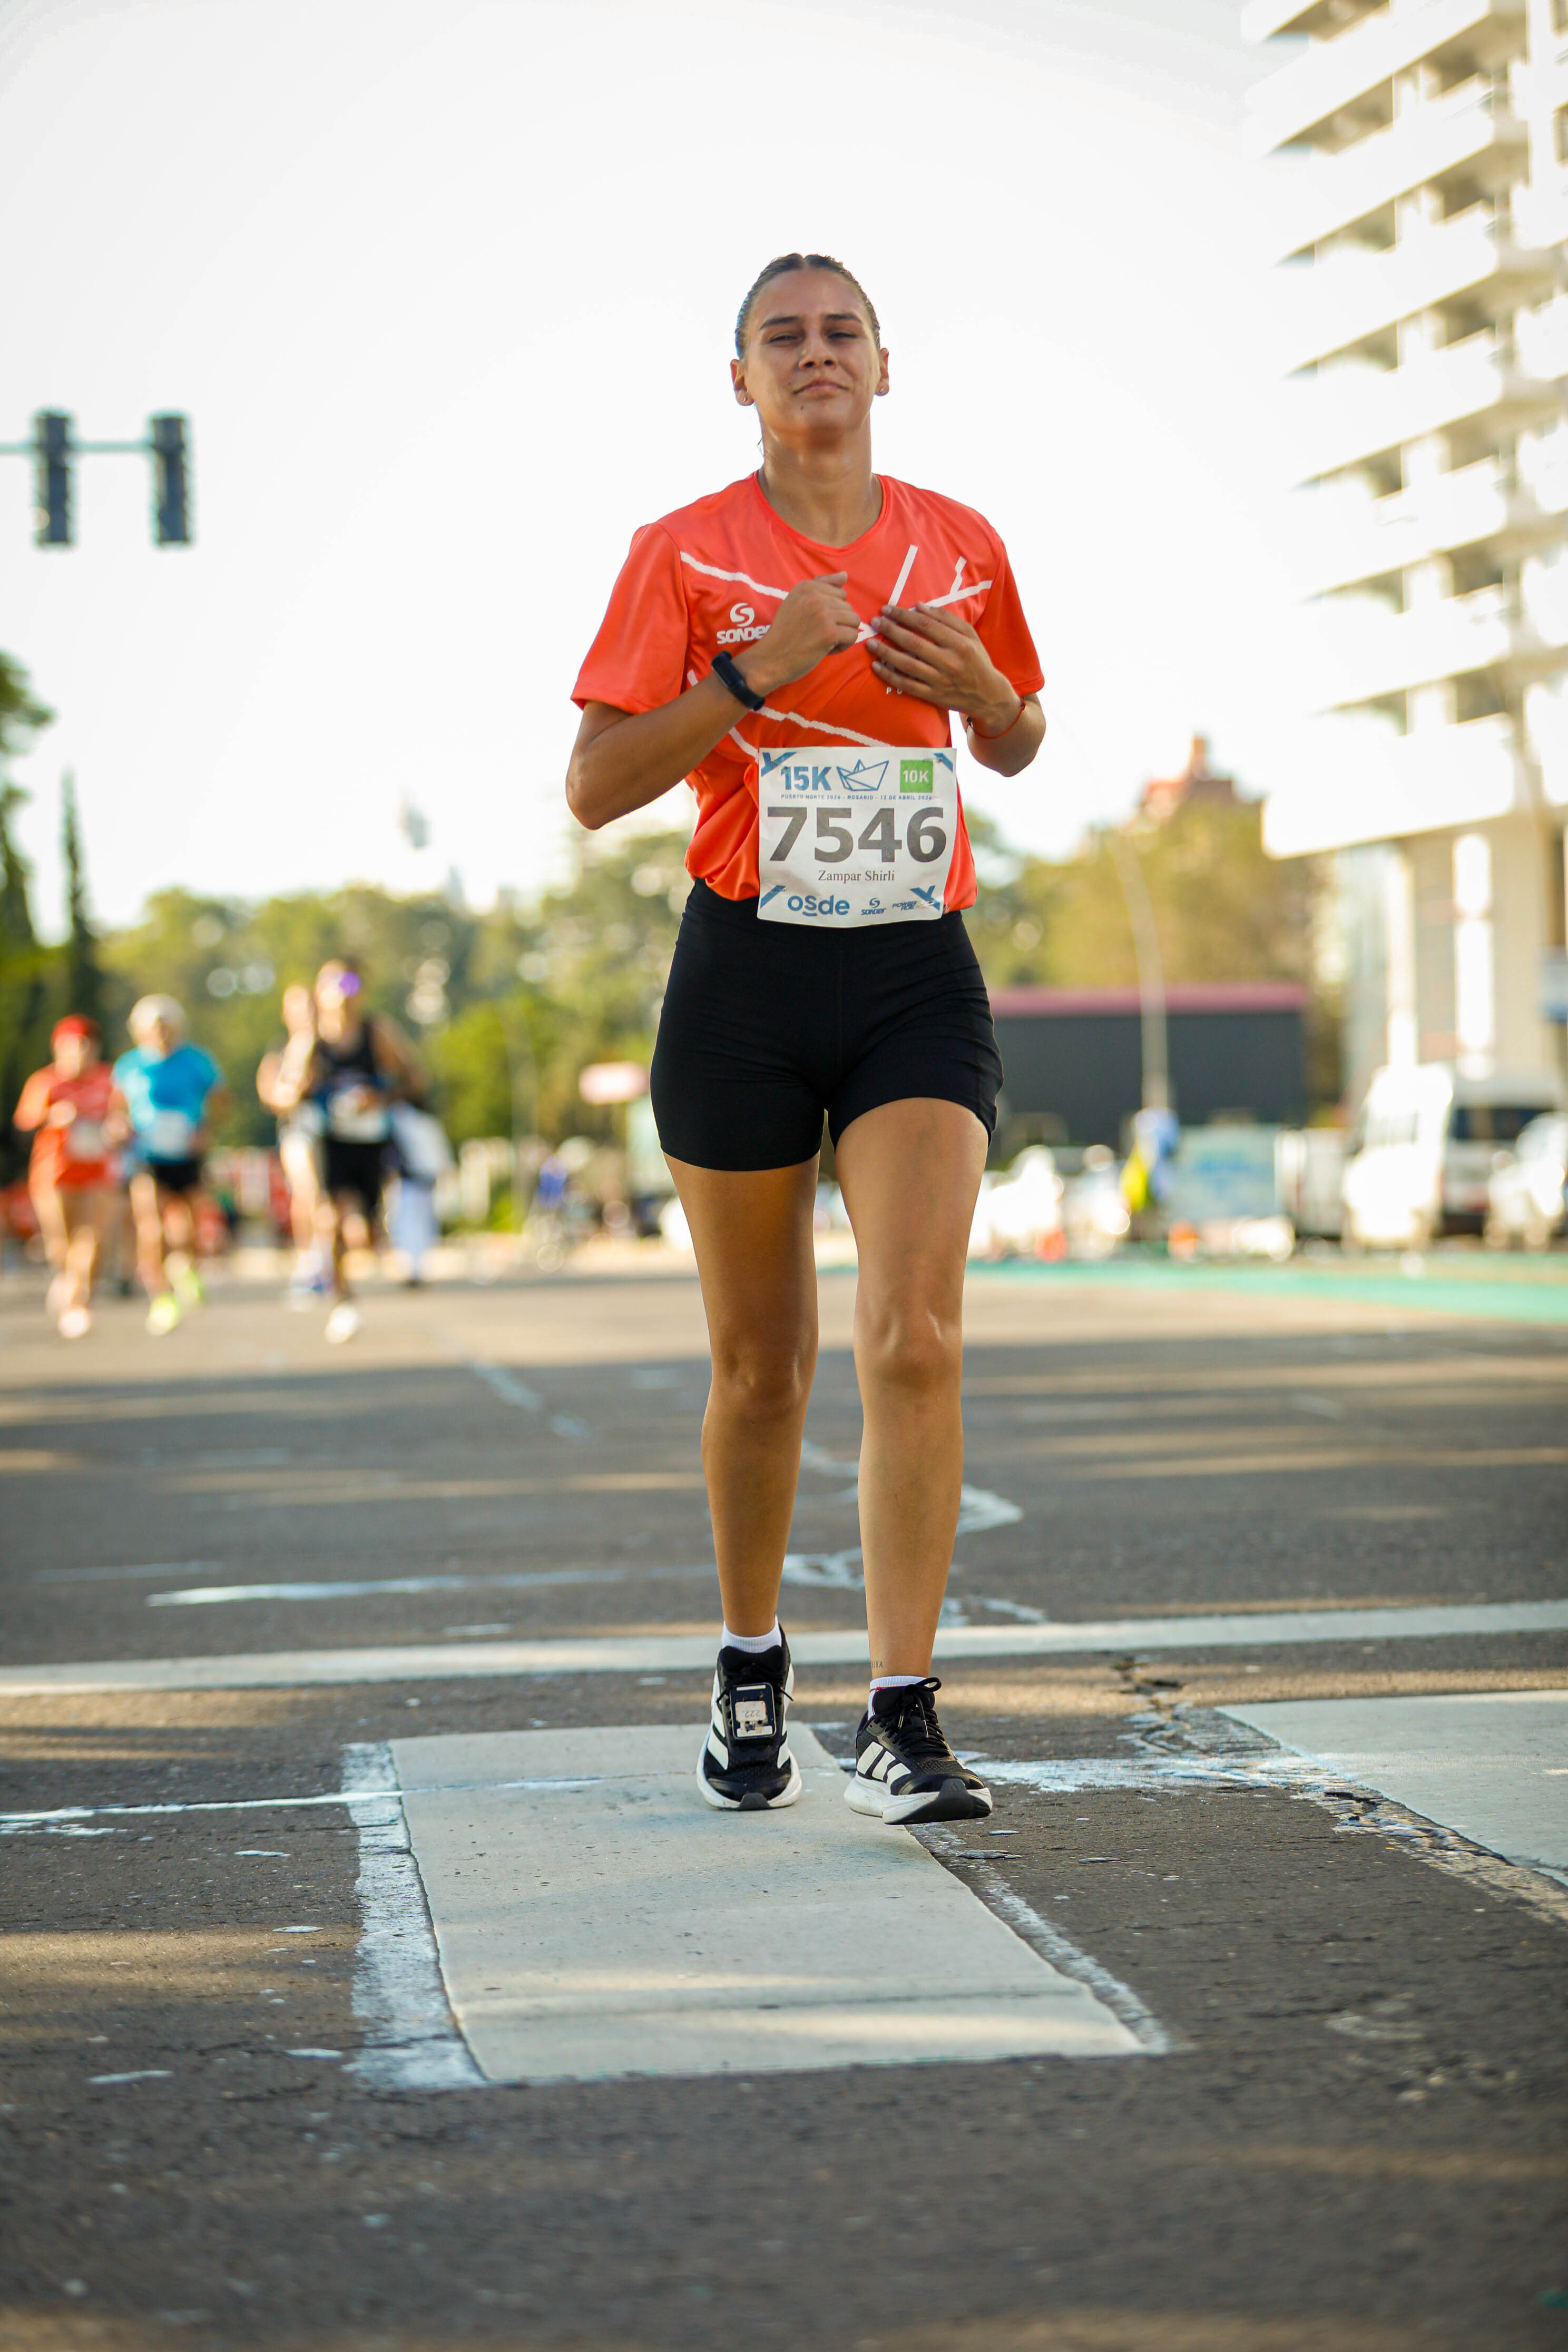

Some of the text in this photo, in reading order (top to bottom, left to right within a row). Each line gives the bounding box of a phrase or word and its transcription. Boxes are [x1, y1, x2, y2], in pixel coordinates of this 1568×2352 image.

[780, 766, 832, 790] 15K
[903, 770, 930, 783] 10K
[767, 807, 947, 863] 7546
[818, 870, 895, 884] Zampar Shirli
[787, 894, 850, 916] osde
